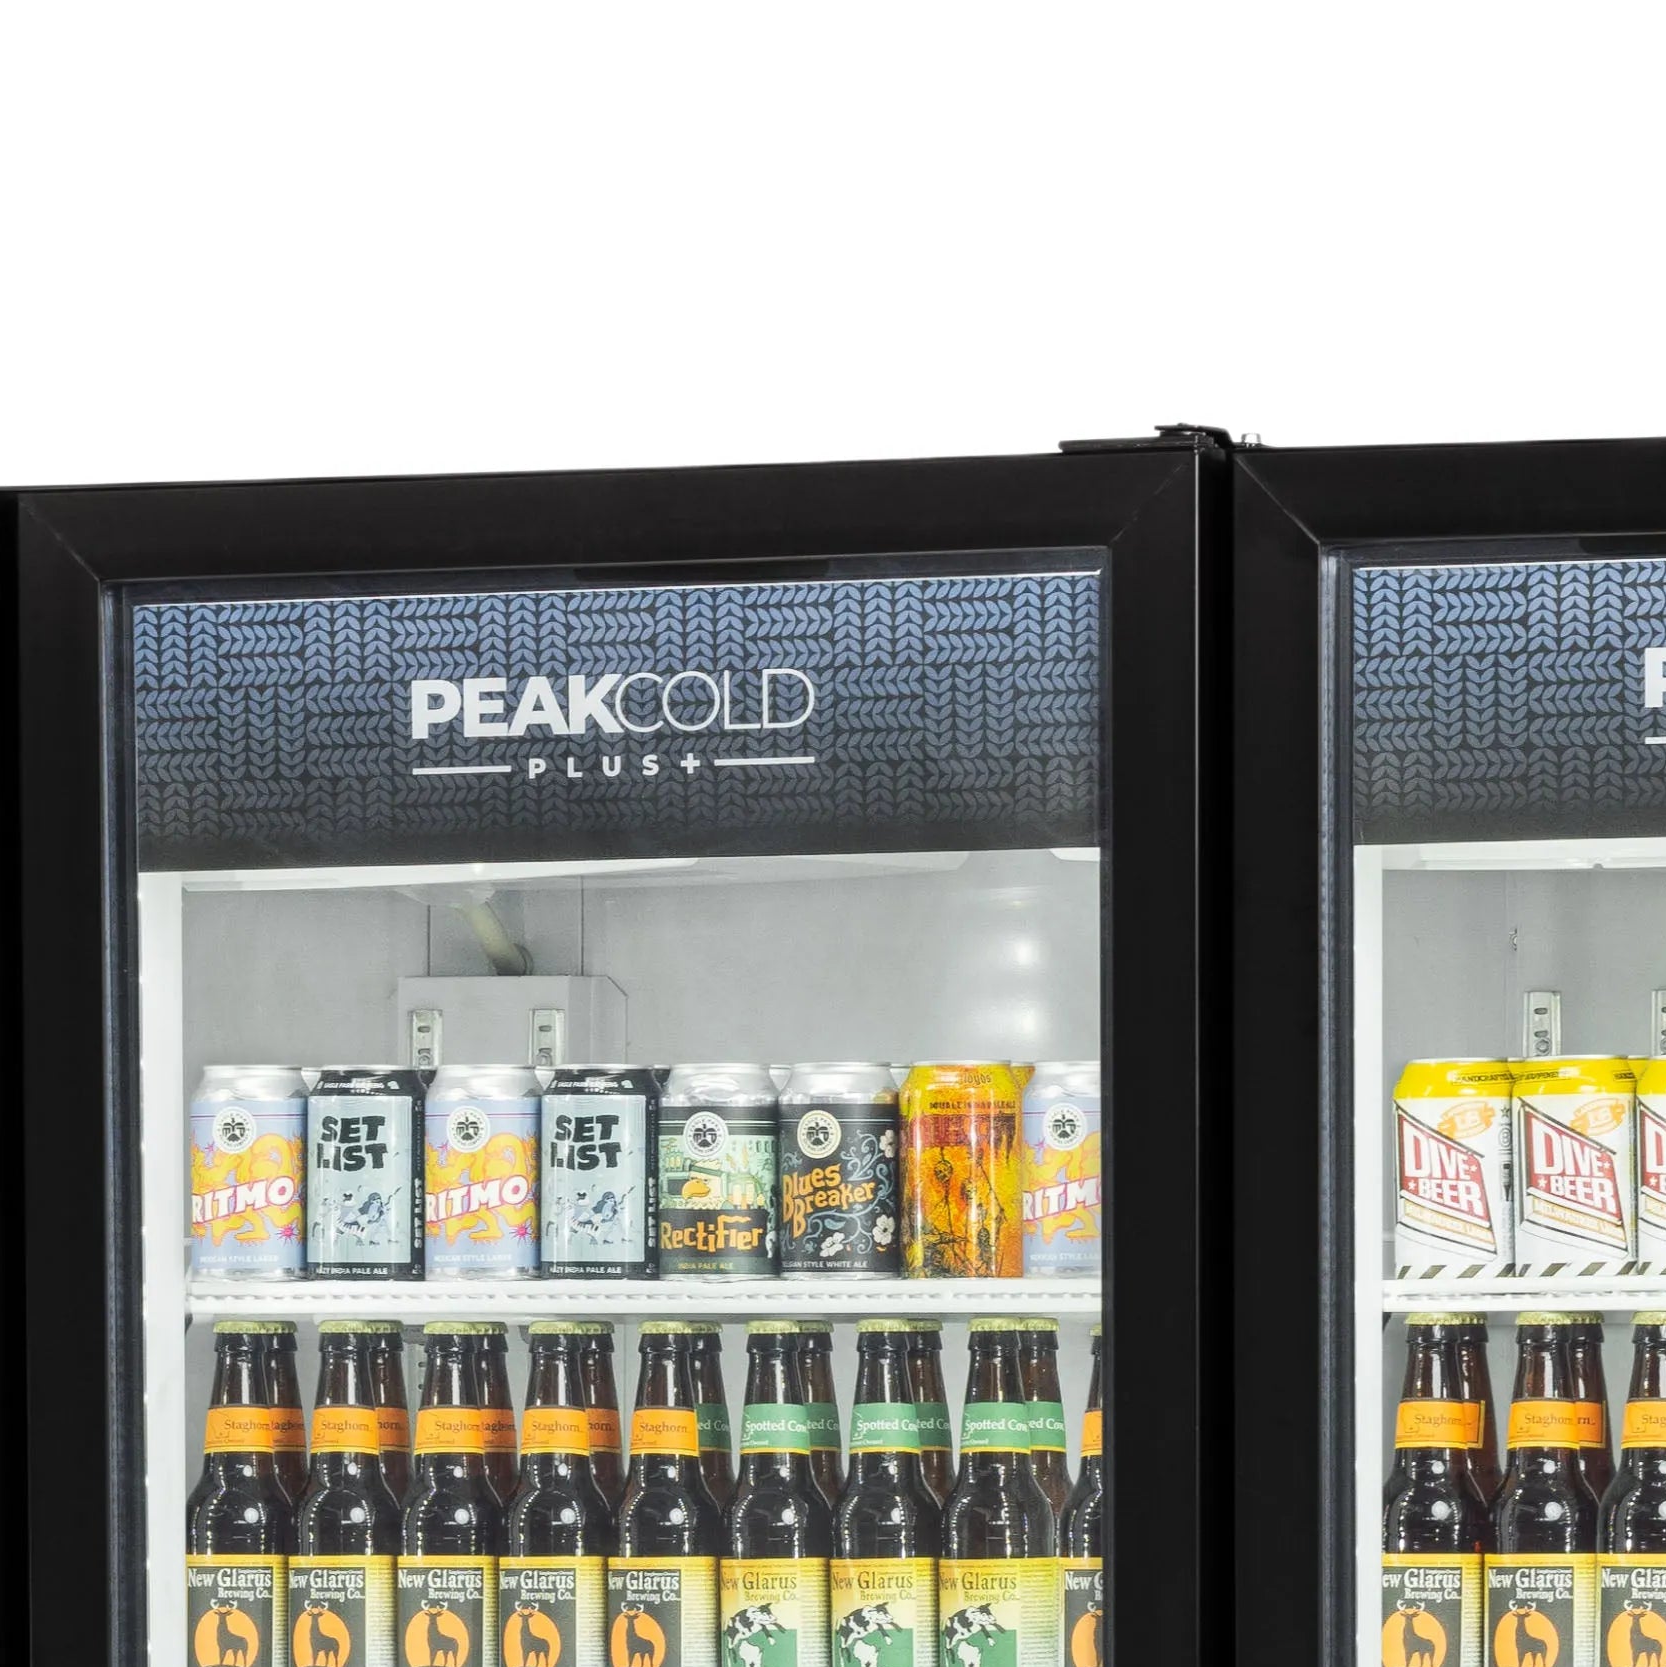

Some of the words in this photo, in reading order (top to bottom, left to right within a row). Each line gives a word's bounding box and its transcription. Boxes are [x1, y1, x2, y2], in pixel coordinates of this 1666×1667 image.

[411, 668, 815, 739] PEAKCOLD
[321, 1115, 386, 1143] SET
[555, 1114, 619, 1143] SET
[317, 1145, 387, 1170] LIST
[551, 1144, 621, 1171] LIST
[1404, 1127, 1470, 1178] DIVE
[1532, 1125, 1605, 1176] DIVE
[192, 1177, 294, 1223] RITMO
[425, 1175, 527, 1223] RITMO
[782, 1164, 840, 1219] Blues
[1418, 1177, 1483, 1216] BEER
[1551, 1175, 1615, 1213] BEER
[793, 1181, 875, 1238] Breaker
[745, 1419, 786, 1434] Spotted
[857, 1420, 897, 1434] Spotted
[188, 1568, 212, 1589] New
[217, 1568, 271, 1589] Glarus
[398, 1570, 426, 1589] New
[428, 1568, 482, 1589] Glarus
[742, 1570, 797, 1591] Glarus
[961, 1571, 1017, 1590] Glarus
[1488, 1571, 1512, 1589] New
[1516, 1570, 1572, 1589] Glarus
[1601, 1569, 1627, 1589] New
